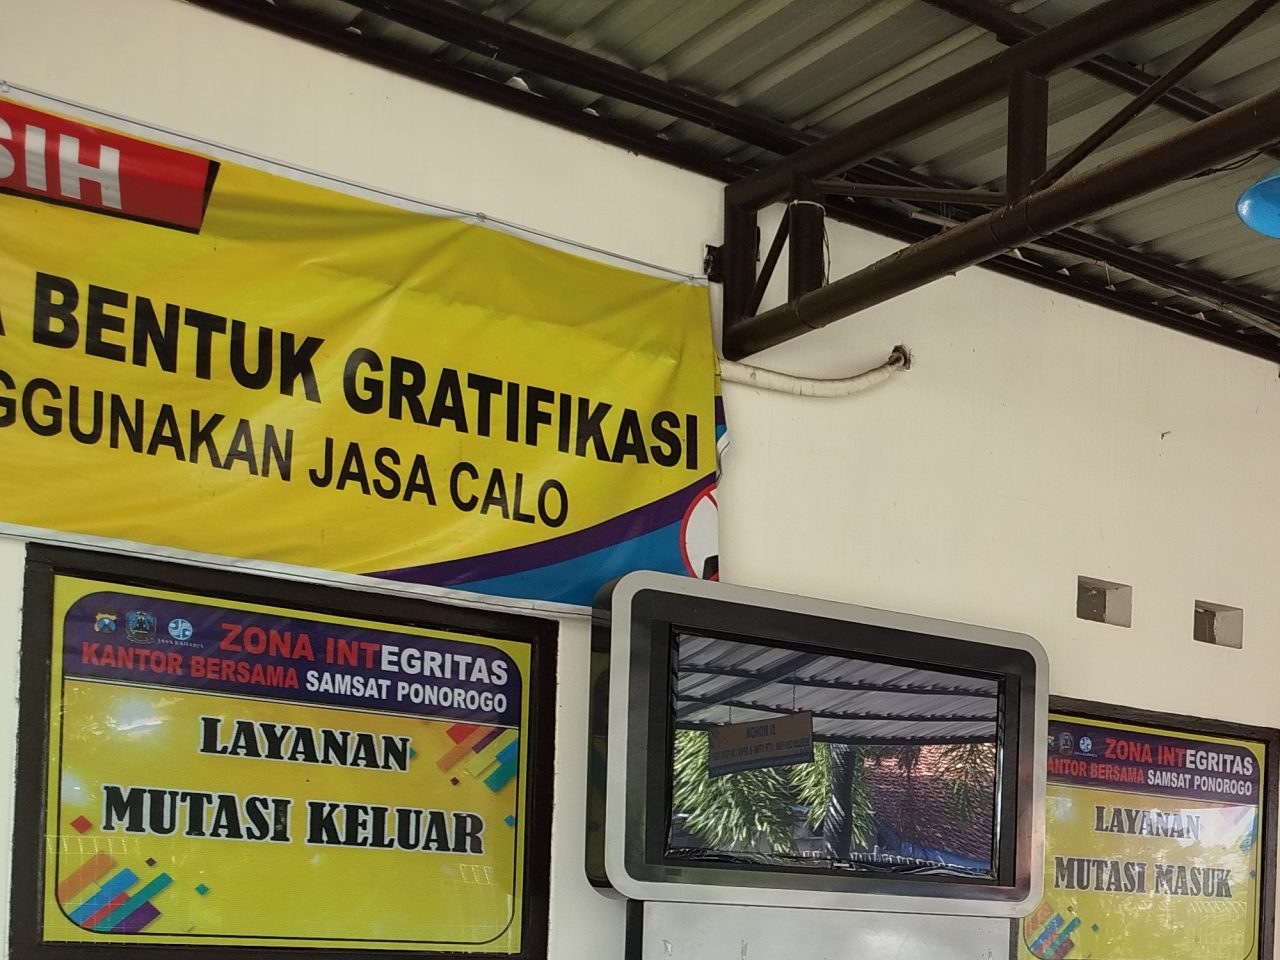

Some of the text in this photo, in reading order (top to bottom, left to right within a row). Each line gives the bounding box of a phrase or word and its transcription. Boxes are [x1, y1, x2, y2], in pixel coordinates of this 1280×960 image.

[32, 271, 698, 470] BENTUK GRATIFIKASI
[309, 437, 436, 505] JASA
[450, 462, 569, 528] CALO
[81, 641, 507, 713] KANTOR BERSAMA SAMSAT PONOROGO
[220, 623, 508, 686] ZONA INTEGRITAS
[201, 716, 410, 772] LAYANAN
[1105, 738, 1253, 776] ZONA INTEGRITAS
[1090, 762, 1144, 784] BERSAMA
[1148, 769, 1191, 789] SAMSAT
[1194, 776, 1252, 796] PONOROGO
[102, 785, 485, 855] MUTASI KELUAR
[1095, 806, 1200, 840] LAYANAN
[1054, 857, 1232, 898] MUTASI MASUK
